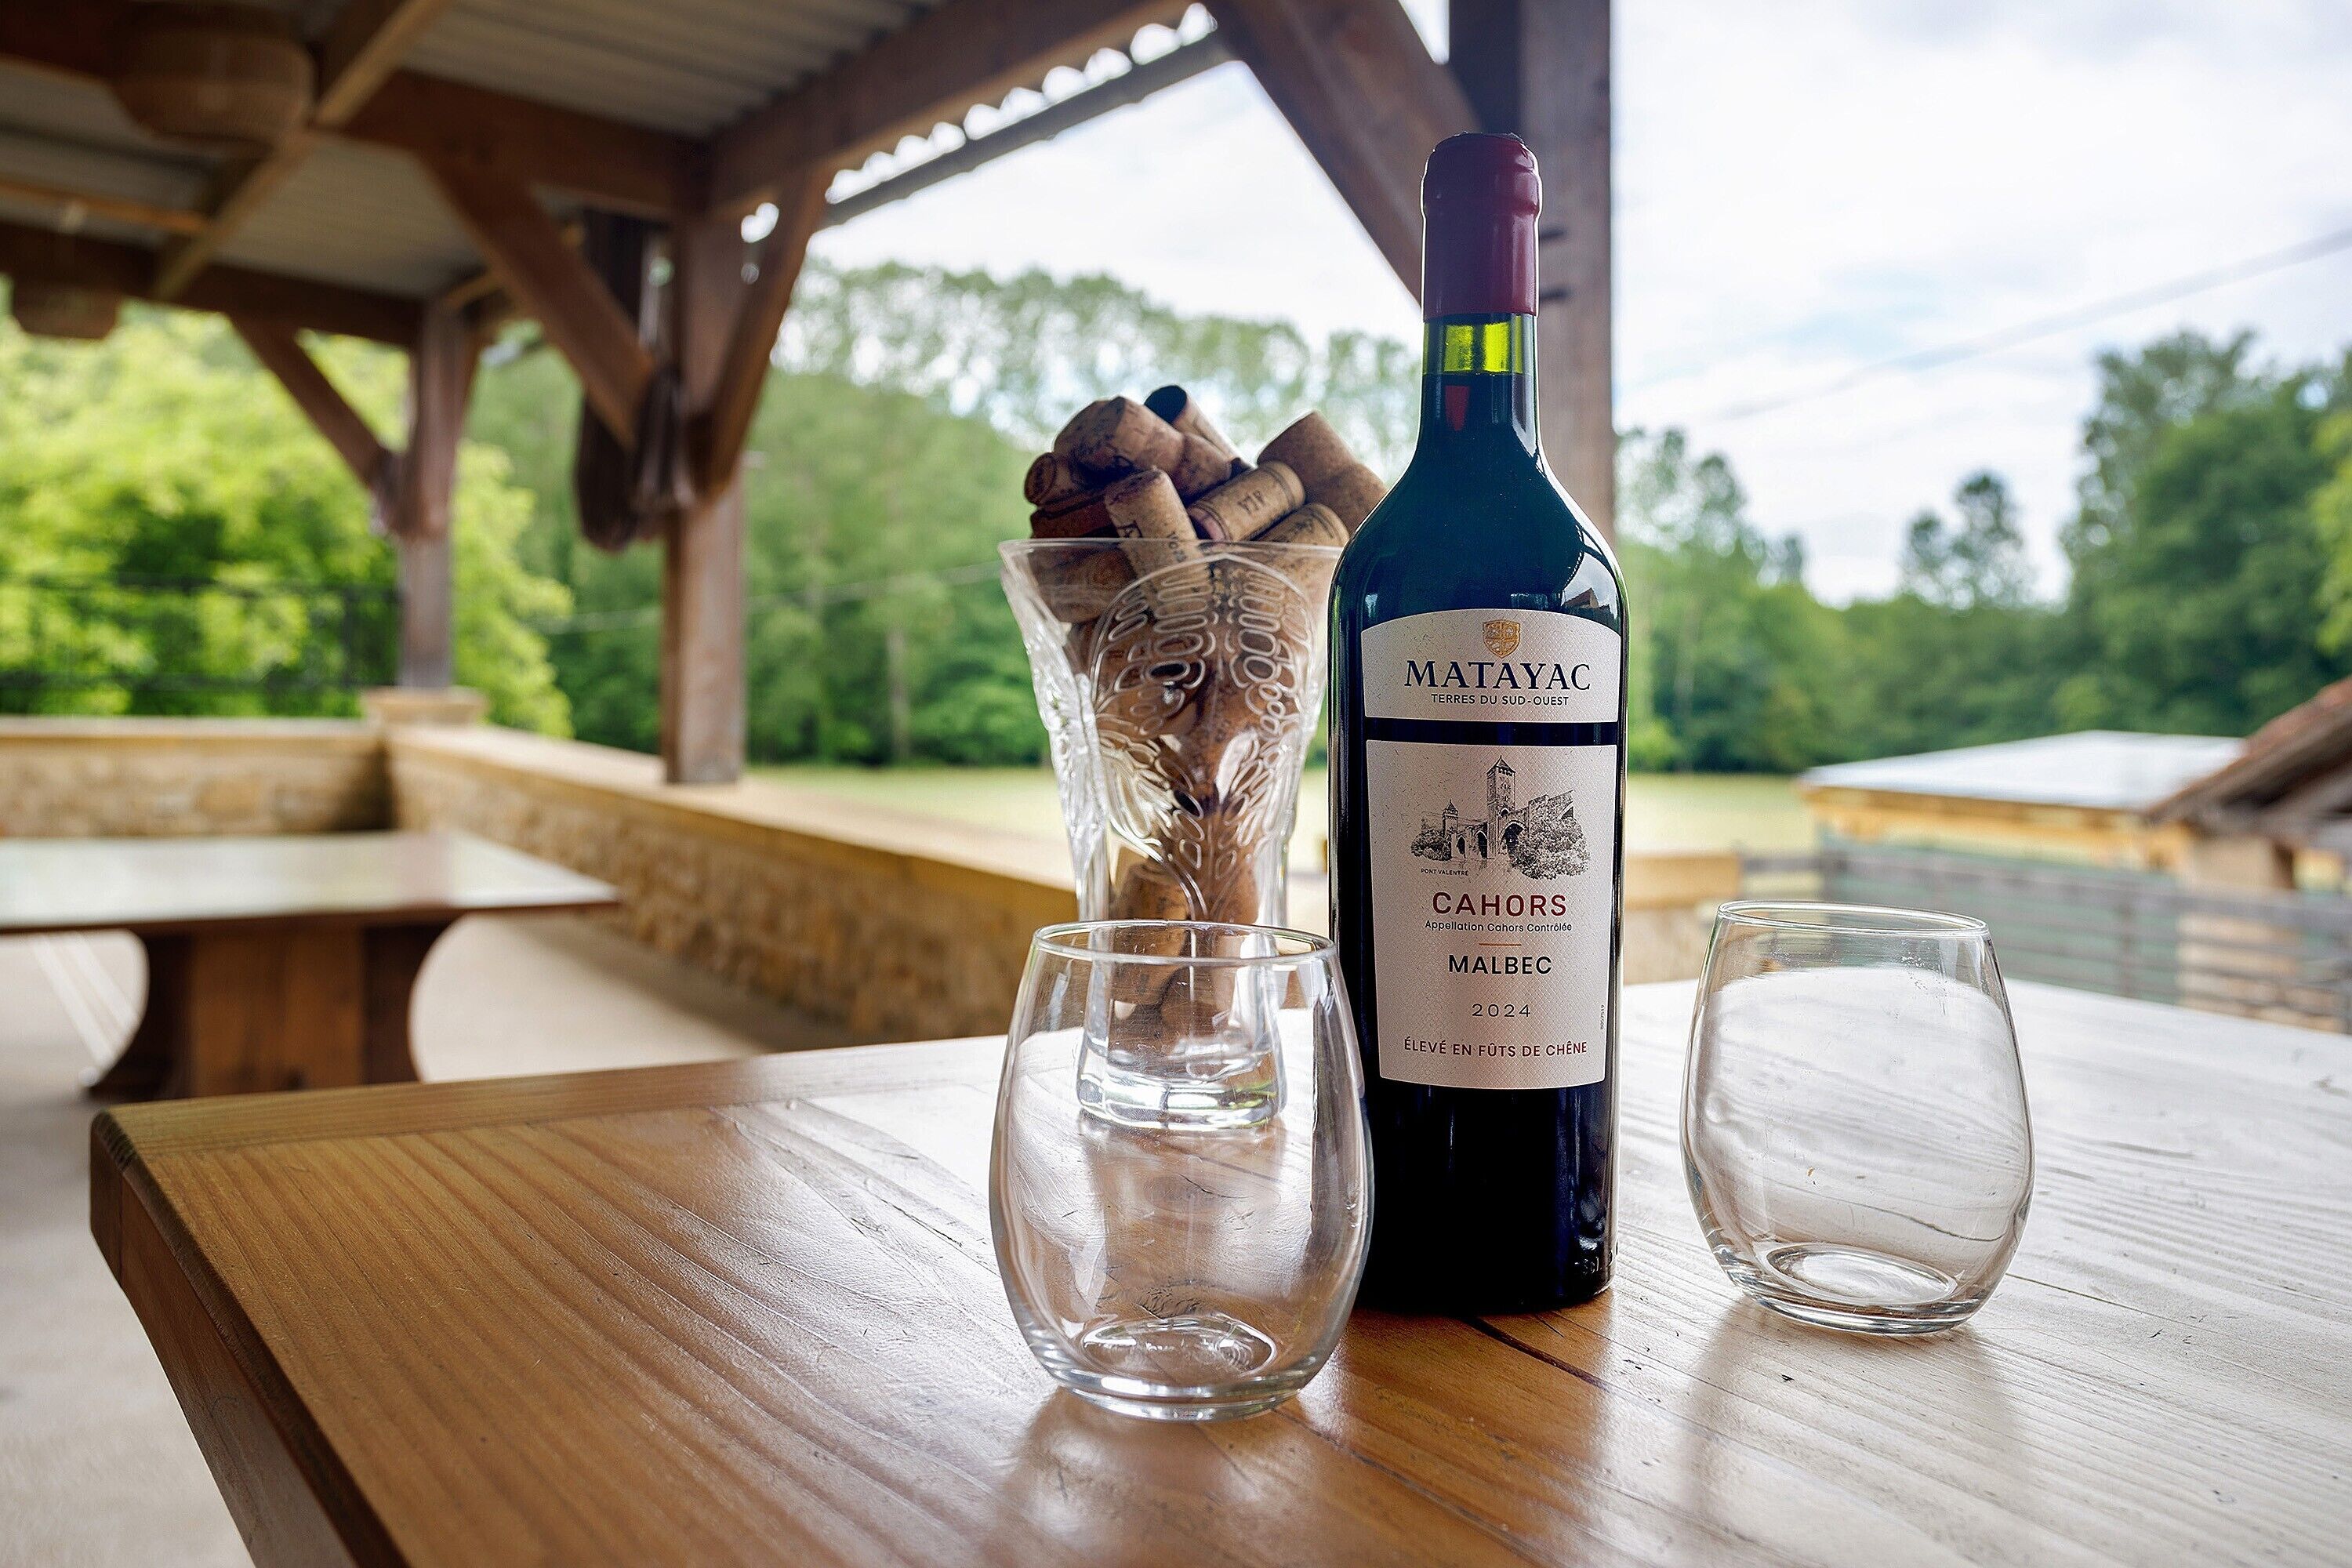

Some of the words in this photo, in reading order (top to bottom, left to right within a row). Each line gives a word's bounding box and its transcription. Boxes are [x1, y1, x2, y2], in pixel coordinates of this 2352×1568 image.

[1403, 660, 1590, 691] MATAYAC
[1431, 693, 1475, 704] TERRES
[1480, 695, 1497, 705] DU
[1501, 695, 1569, 706] SUD-OUEST
[1432, 891, 1566, 917] CAHORS
[1425, 920, 1484, 931] Appellation
[1486, 923, 1524, 932] Cahors
[1526, 922, 1572, 932] Contrôlée
[1449, 954, 1552, 975] MALBEC
[1472, 1003, 1531, 1018] 2024
[1404, 1036, 1446, 1054] ÉLEVÉ
[1453, 1044, 1472, 1056] EN
[1478, 1042, 1516, 1058] FÛTS
[1522, 1045, 1541, 1057] DE
[1545, 1040, 1587, 1056] CHÊNE
